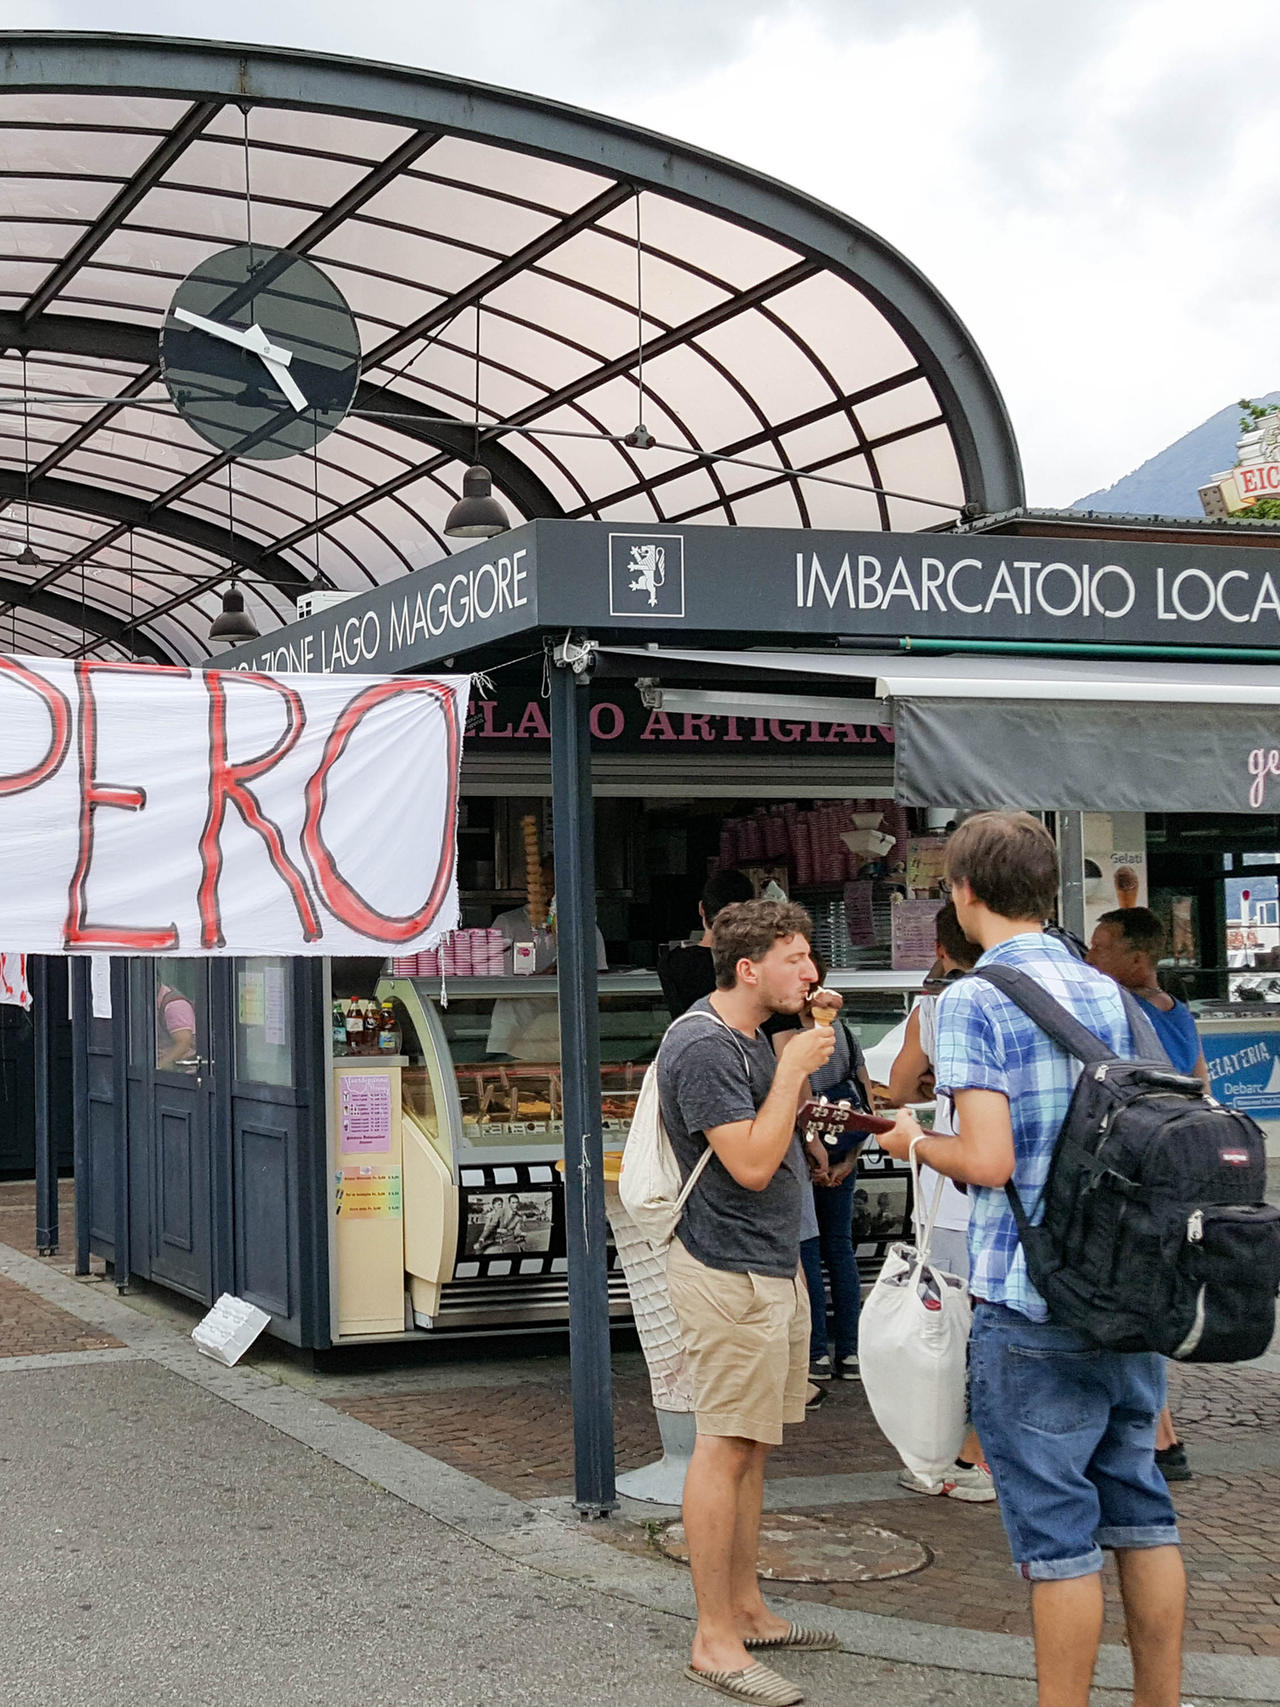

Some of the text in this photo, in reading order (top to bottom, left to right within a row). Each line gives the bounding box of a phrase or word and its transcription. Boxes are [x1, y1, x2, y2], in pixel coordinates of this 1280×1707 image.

[322, 611, 381, 673] LAGO
[389, 549, 528, 652] MAGGIORE
[796, 552, 1136, 619] IMBARCATOIO
[1110, 853, 1143, 865] Gelati
[1208, 1042, 1272, 1082] ELATERIA
